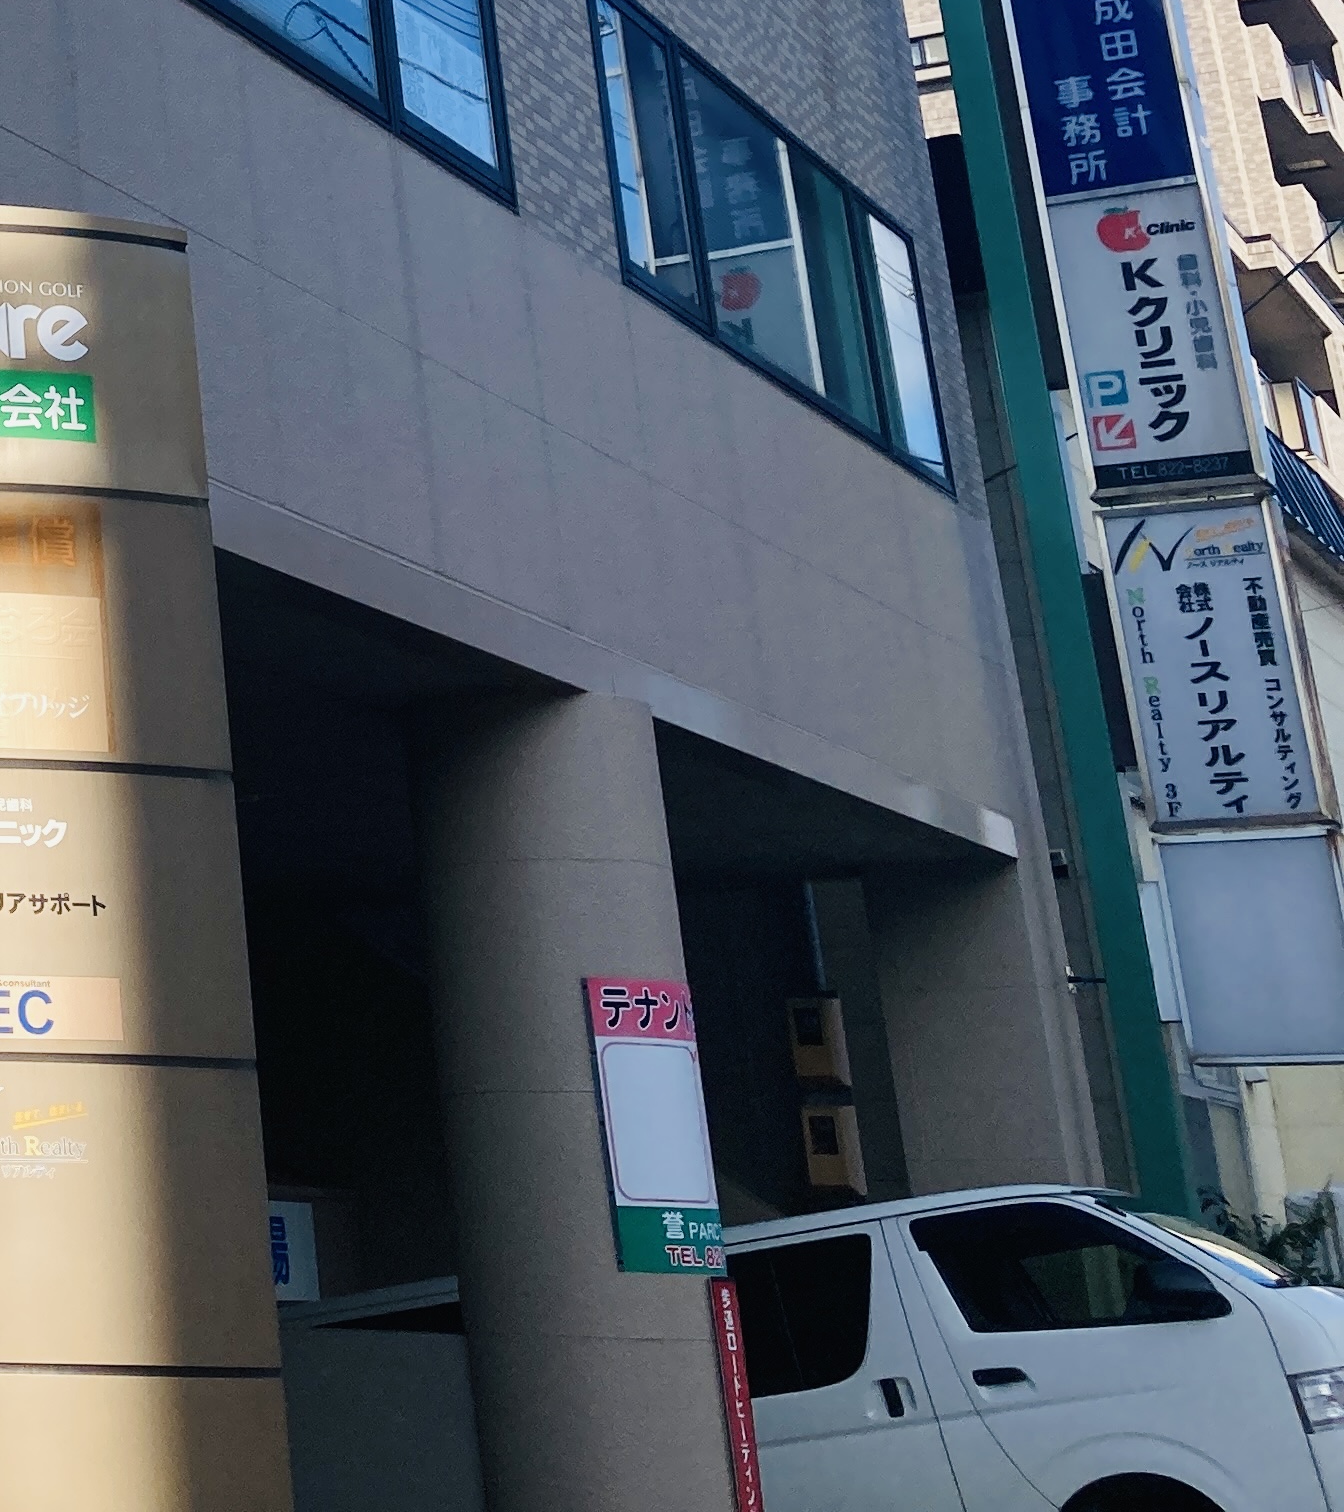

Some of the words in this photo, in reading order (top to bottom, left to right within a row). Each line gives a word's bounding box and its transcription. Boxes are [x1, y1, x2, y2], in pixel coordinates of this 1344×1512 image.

[1054, 74, 1108, 186] 事務所
[1146, 219, 1196, 237] Clinic
[38, 281, 85, 299] GOLF
[1120, 257, 1191, 442] Kクリニック
[1116, 465, 1157, 480] TEL
[1184, 617, 1250, 814] ノースリアルティ
[1264, 678, 1302, 810] コンサルティング
[23, 1135, 88, 1160] Realty
[665, 1245, 704, 1267] TEL
